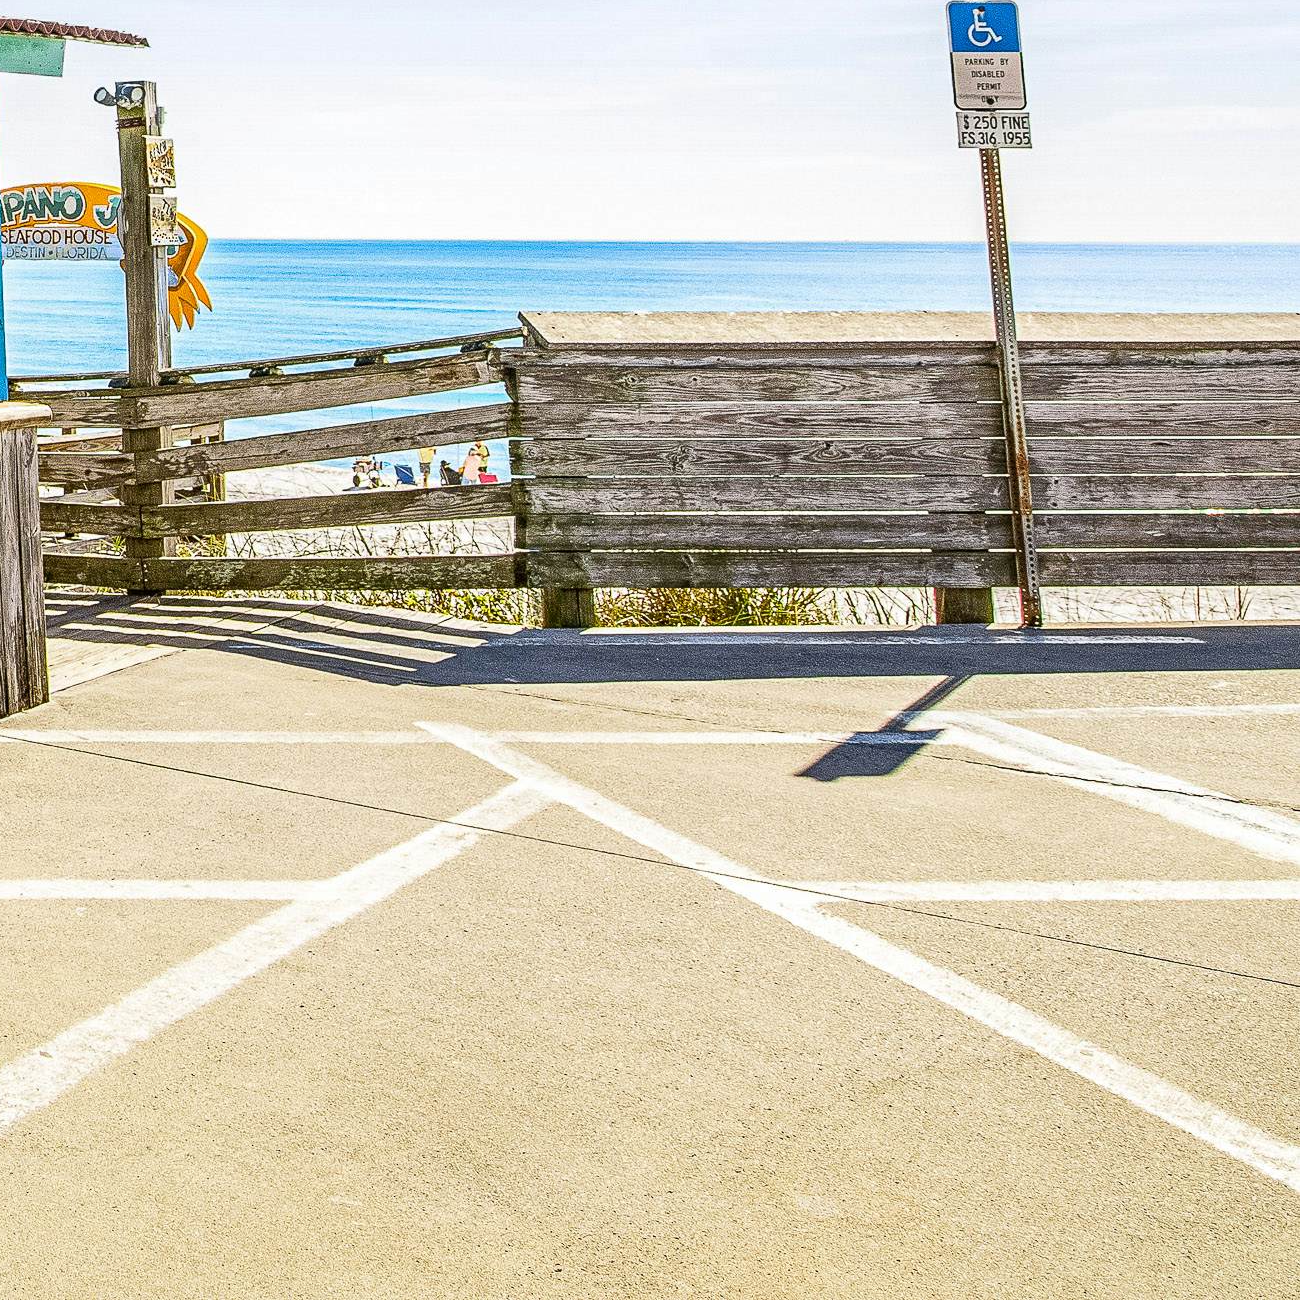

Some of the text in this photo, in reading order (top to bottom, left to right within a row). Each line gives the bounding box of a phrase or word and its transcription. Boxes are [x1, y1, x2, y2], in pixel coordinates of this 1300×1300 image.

[964, 58, 1009, 66] PARKING BY
[971, 70, 1005, 78] DISABLED
[976, 82, 1001, 90] PERMIT
[1001, 116, 1030, 130] FINE
[0, 186, 84, 223] PANO
[1, 229, 112, 245] SEAFOOD HOUSE
[6, 246, 108, 259] DESTIN FLORIDA
